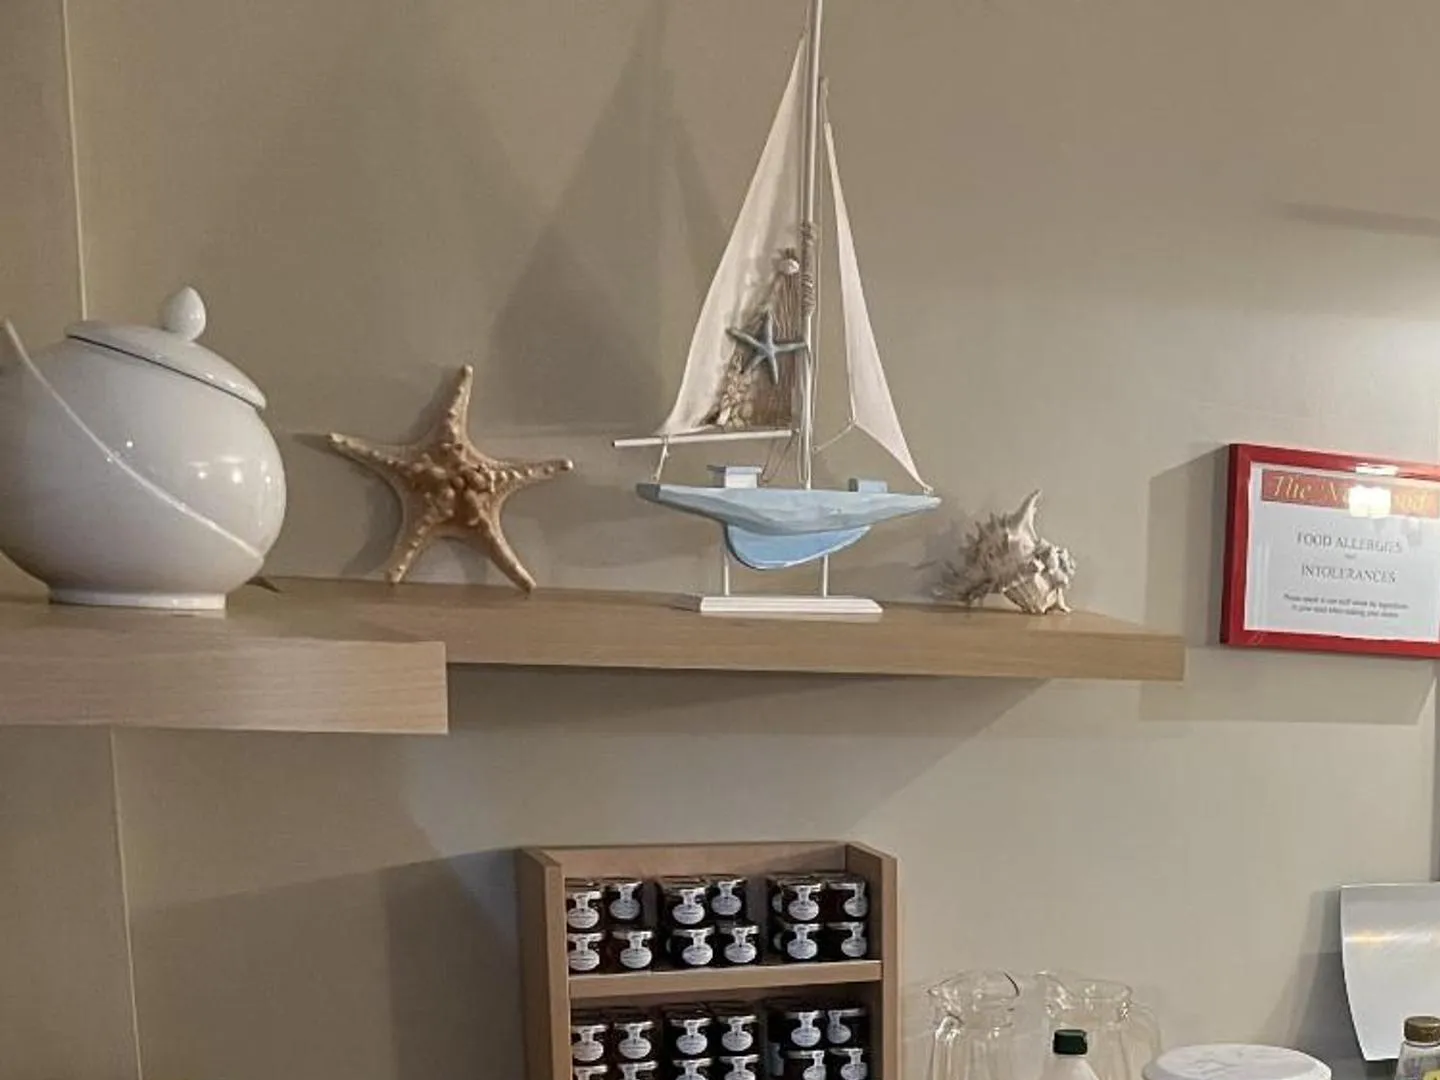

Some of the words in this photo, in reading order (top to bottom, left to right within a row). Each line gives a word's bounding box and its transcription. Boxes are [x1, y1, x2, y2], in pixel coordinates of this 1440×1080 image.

[1272, 475, 1311, 498] The
[1297, 532, 1332, 548] FOOD
[1302, 563, 1397, 583] INTOLERANCES
